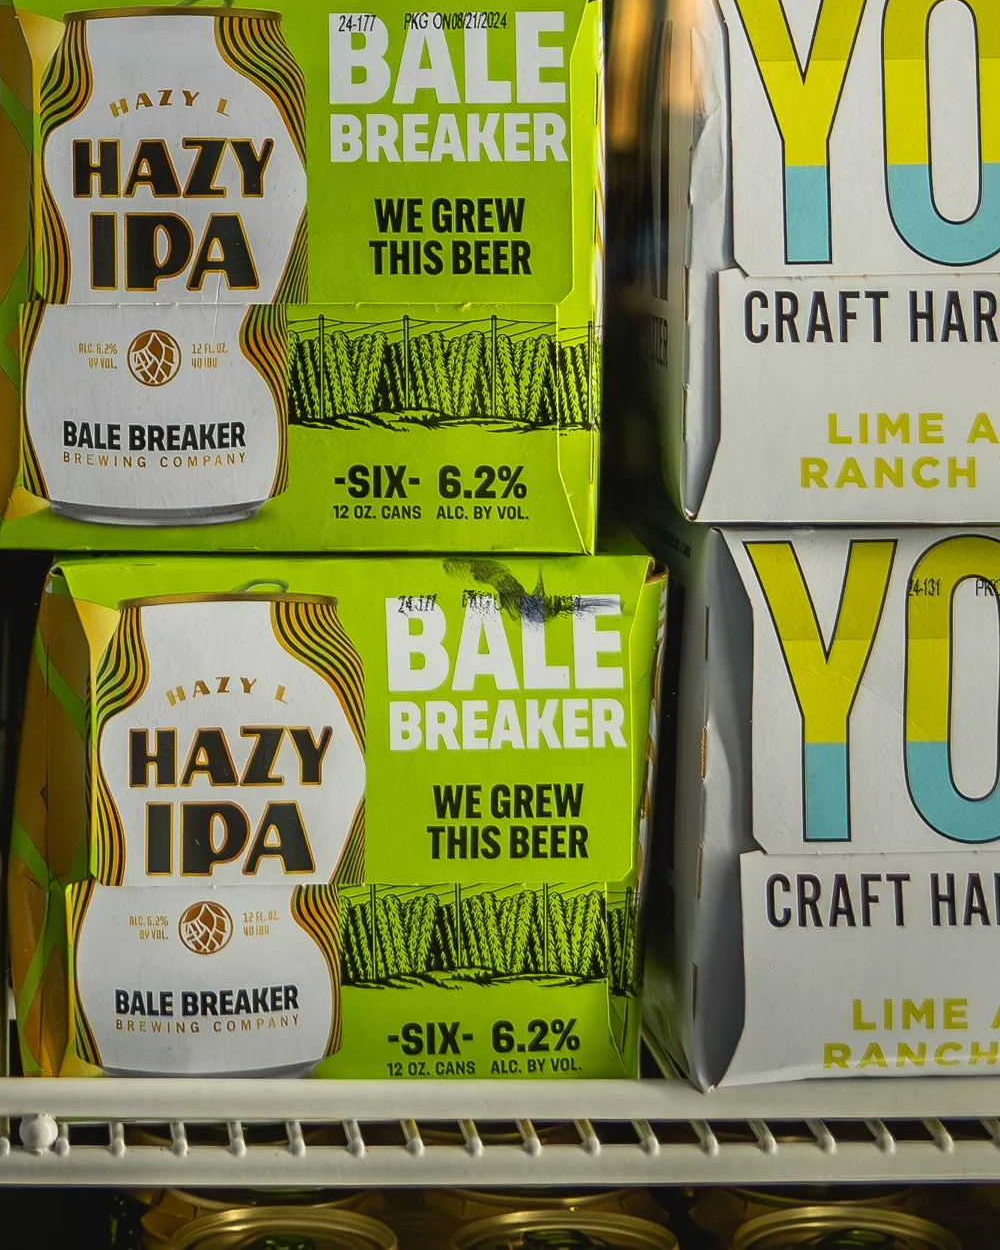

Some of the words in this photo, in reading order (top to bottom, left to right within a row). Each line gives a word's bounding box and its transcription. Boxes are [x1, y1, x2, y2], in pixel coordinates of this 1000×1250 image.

[339, 15, 376, 33] 24-177
[405, 13, 429, 30] PKG
[328, 11, 567, 105] BALE
[109, 90, 199, 118] HAZY
[329, 113, 568, 163] BREAKER
[72, 137, 274, 199] HAZY
[90, 212, 260, 292] IPA
[744, 290, 889, 344] CRAFT
[63, 420, 120, 450] BALE
[129, 422, 246, 450] BREAKER
[827, 413, 944, 444] LIME
[63, 452, 146, 468] BREWING
[160, 452, 246, 468] COMPANY
[800, 456, 976, 489] RANCH
[438, 466, 527, 499] 6.2%
[332, 506, 349, 519] 12
[353, 506, 376, 520] OZ.
[381, 506, 421, 520] CANS
[436, 506, 468, 520] ALC.
[473, 506, 492, 520] BY
[498, 506, 530, 520] VOL.
[385, 595, 623, 693] BALE
[389, 699, 627, 751] BREAKER
[129, 726, 334, 788] HAZY
[146, 801, 316, 876] IPA
[766, 873, 910, 927] CRAFT
[115, 989, 173, 1016] BALE
[181, 985, 299, 1016] BREAKER
[852, 999, 967, 1030] LIME
[116, 1019, 199, 1033] BREWING
[214, 1014, 299, 1031] COMPANY
